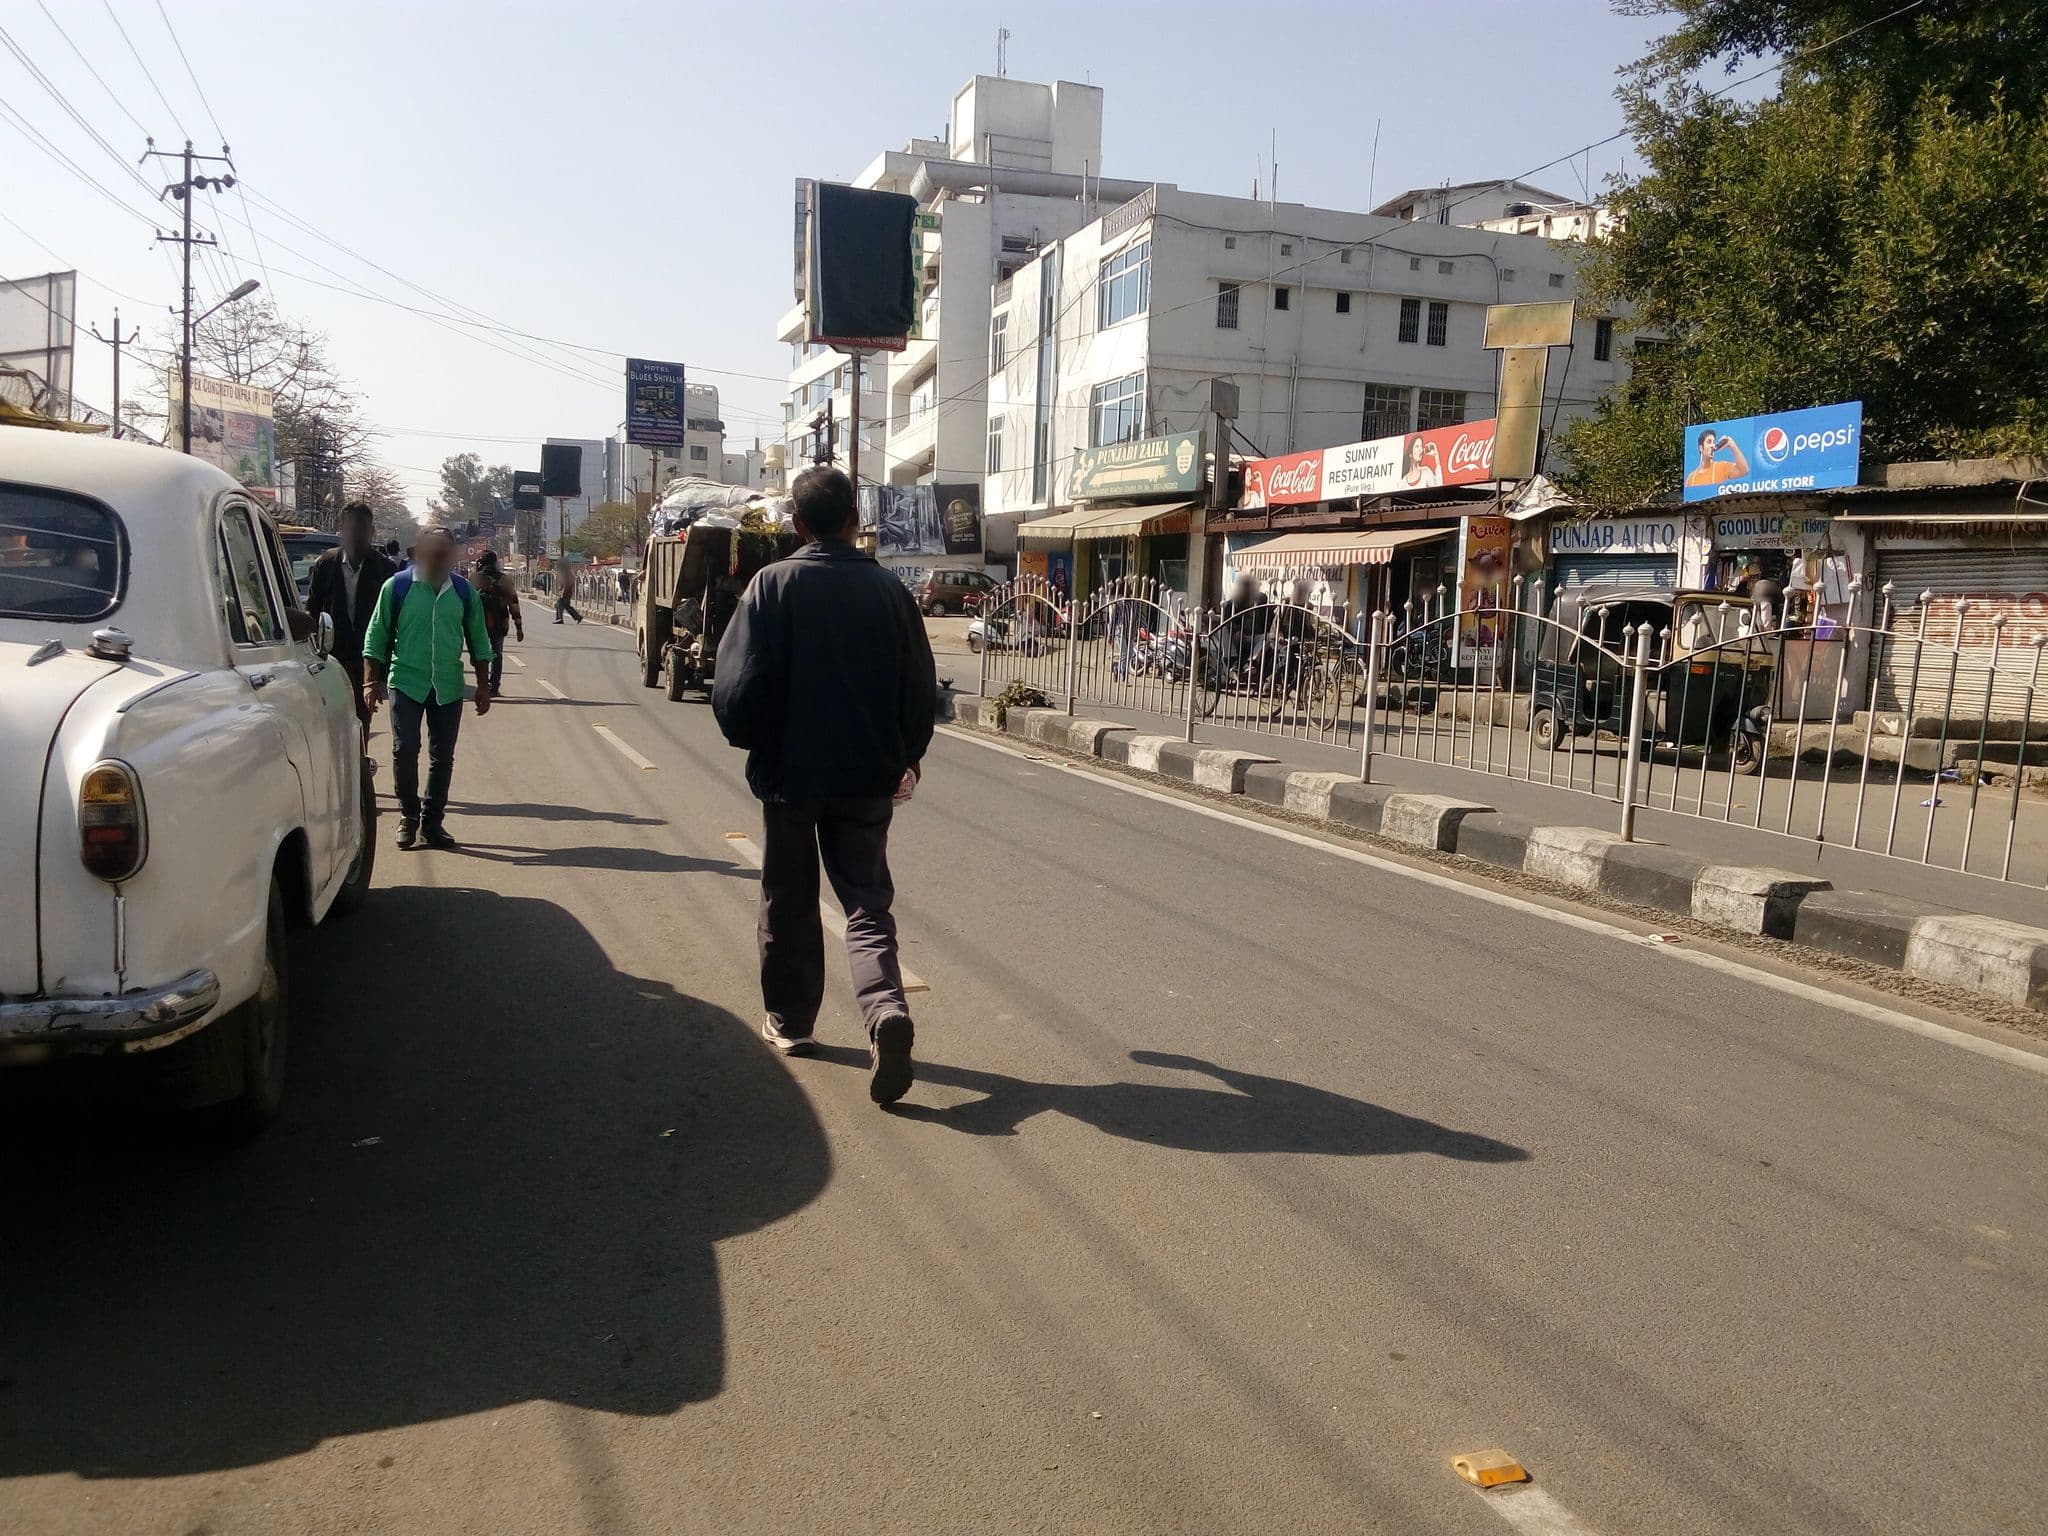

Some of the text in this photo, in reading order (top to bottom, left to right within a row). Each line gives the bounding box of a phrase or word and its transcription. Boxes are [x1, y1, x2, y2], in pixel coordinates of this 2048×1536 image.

[644, 364, 670, 373] HOTEL
[1139, 440, 1169, 460] ZAIKA
[1793, 424, 1853, 456] pepsi
[1345, 446, 1380, 464] SUNNY
[1328, 462, 1395, 484] RESTAURANT
[1717, 475, 1815, 496] GOOD LUCK STORE
[1552, 523, 1676, 549] PUNJAB AUTO
